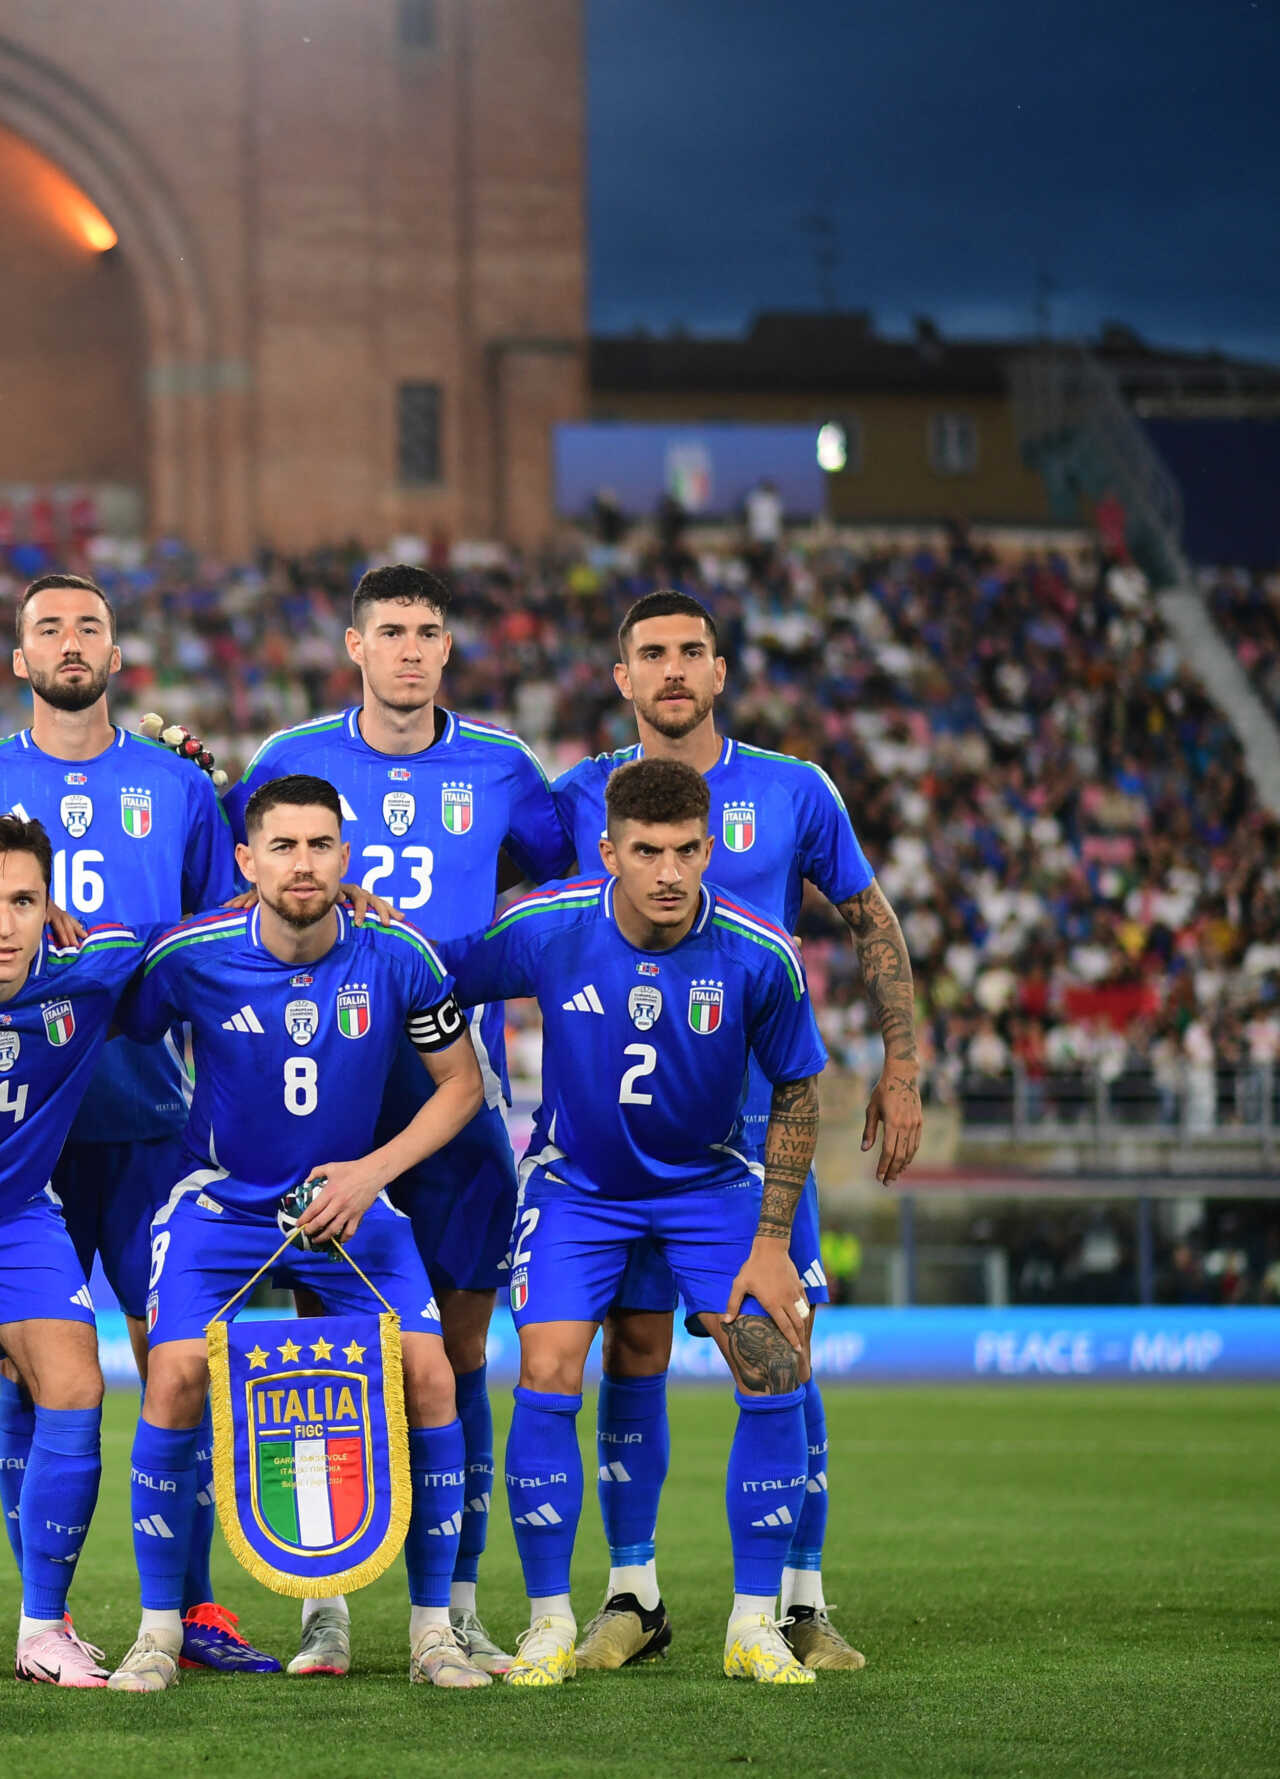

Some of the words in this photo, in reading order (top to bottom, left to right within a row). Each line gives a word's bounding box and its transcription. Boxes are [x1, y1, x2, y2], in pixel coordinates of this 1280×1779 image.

[725, 812, 752, 822] ITALIA
[53, 849, 104, 913] 16
[361, 844, 434, 909] 23
[45, 1003, 70, 1021] ITALIA
[339, 994, 366, 1006] ITALIA
[692, 991, 720, 1002] ITALIA
[283, 1056, 318, 1117] 8
[619, 1043, 657, 1105] 2
[511, 1207, 540, 1269] 2
[148, 1230, 171, 1290] 8
[974, 1330, 1094, 1375] PEACE
[257, 1386, 359, 1424] ITALIA
[295, 1424, 324, 1438] FIGC
[742, 1474, 807, 1493] ITALIA
